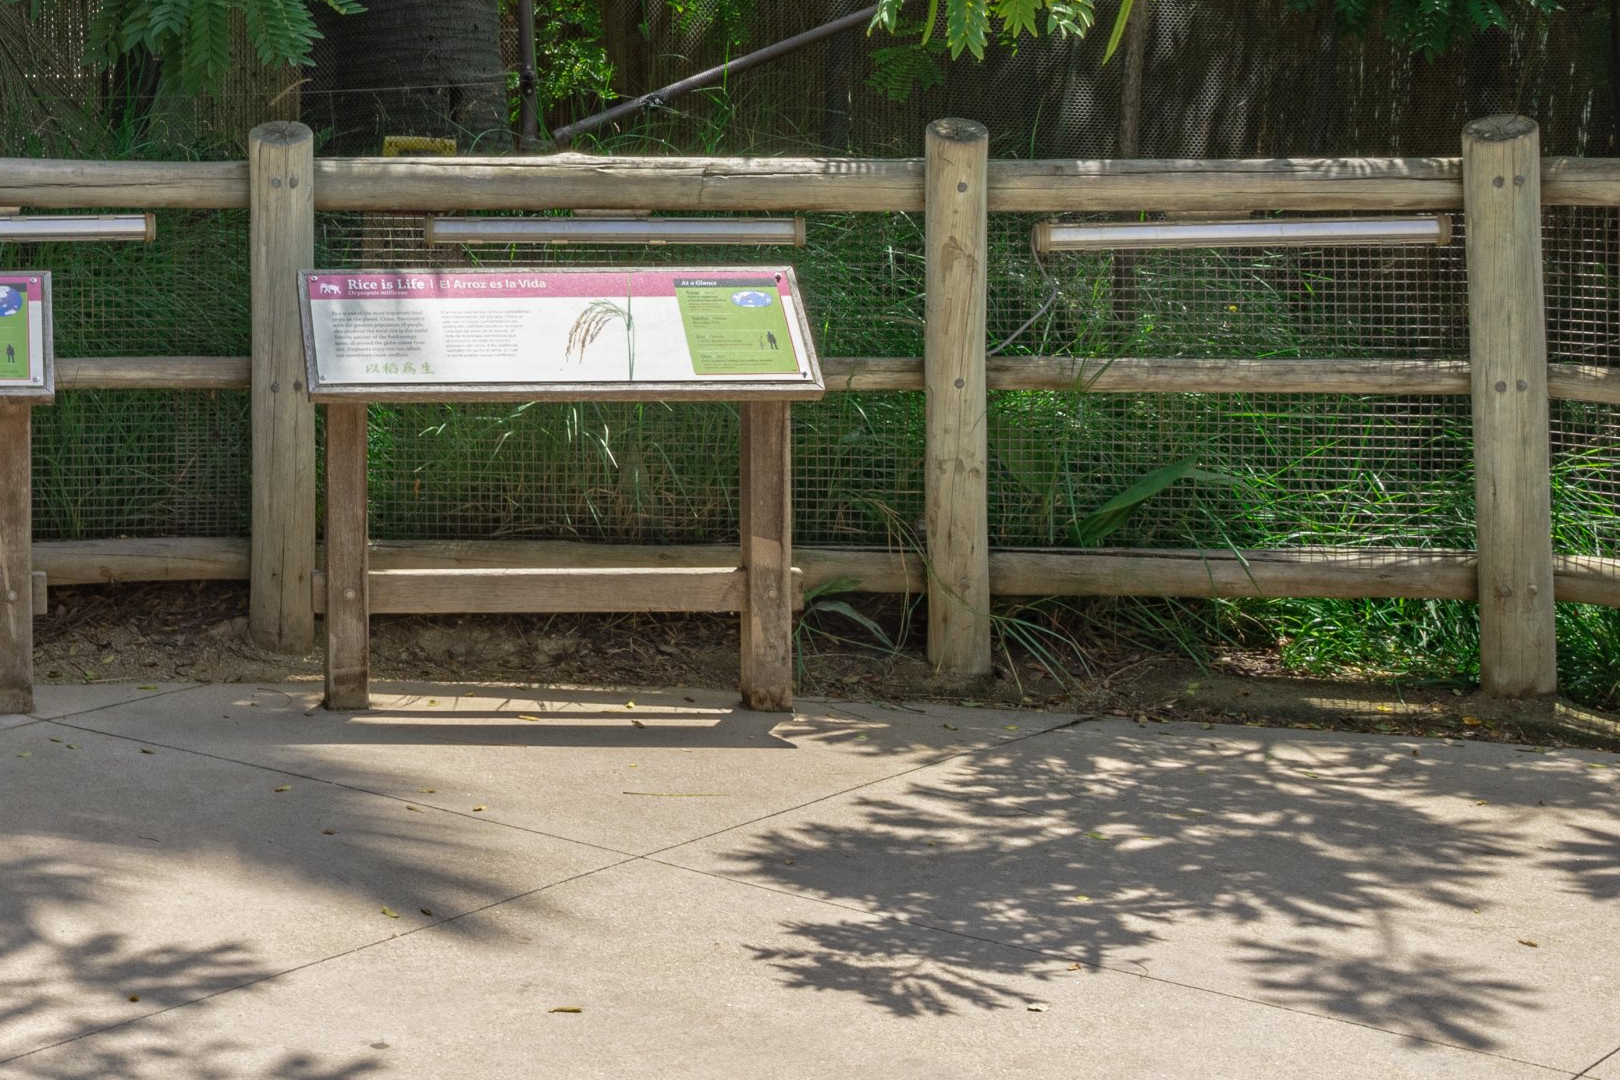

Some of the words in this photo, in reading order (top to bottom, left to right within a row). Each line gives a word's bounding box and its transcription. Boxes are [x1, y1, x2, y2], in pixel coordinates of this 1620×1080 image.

[347, 279, 378, 290] Rice
[380, 279, 393, 290] is
[396, 278, 425, 289] Life
[439, 279, 450, 289] El
[453, 279, 487, 289] Arroz
[490, 280, 503, 289] es
[505, 279, 517, 289] la
[518, 279, 547, 289] Vida
